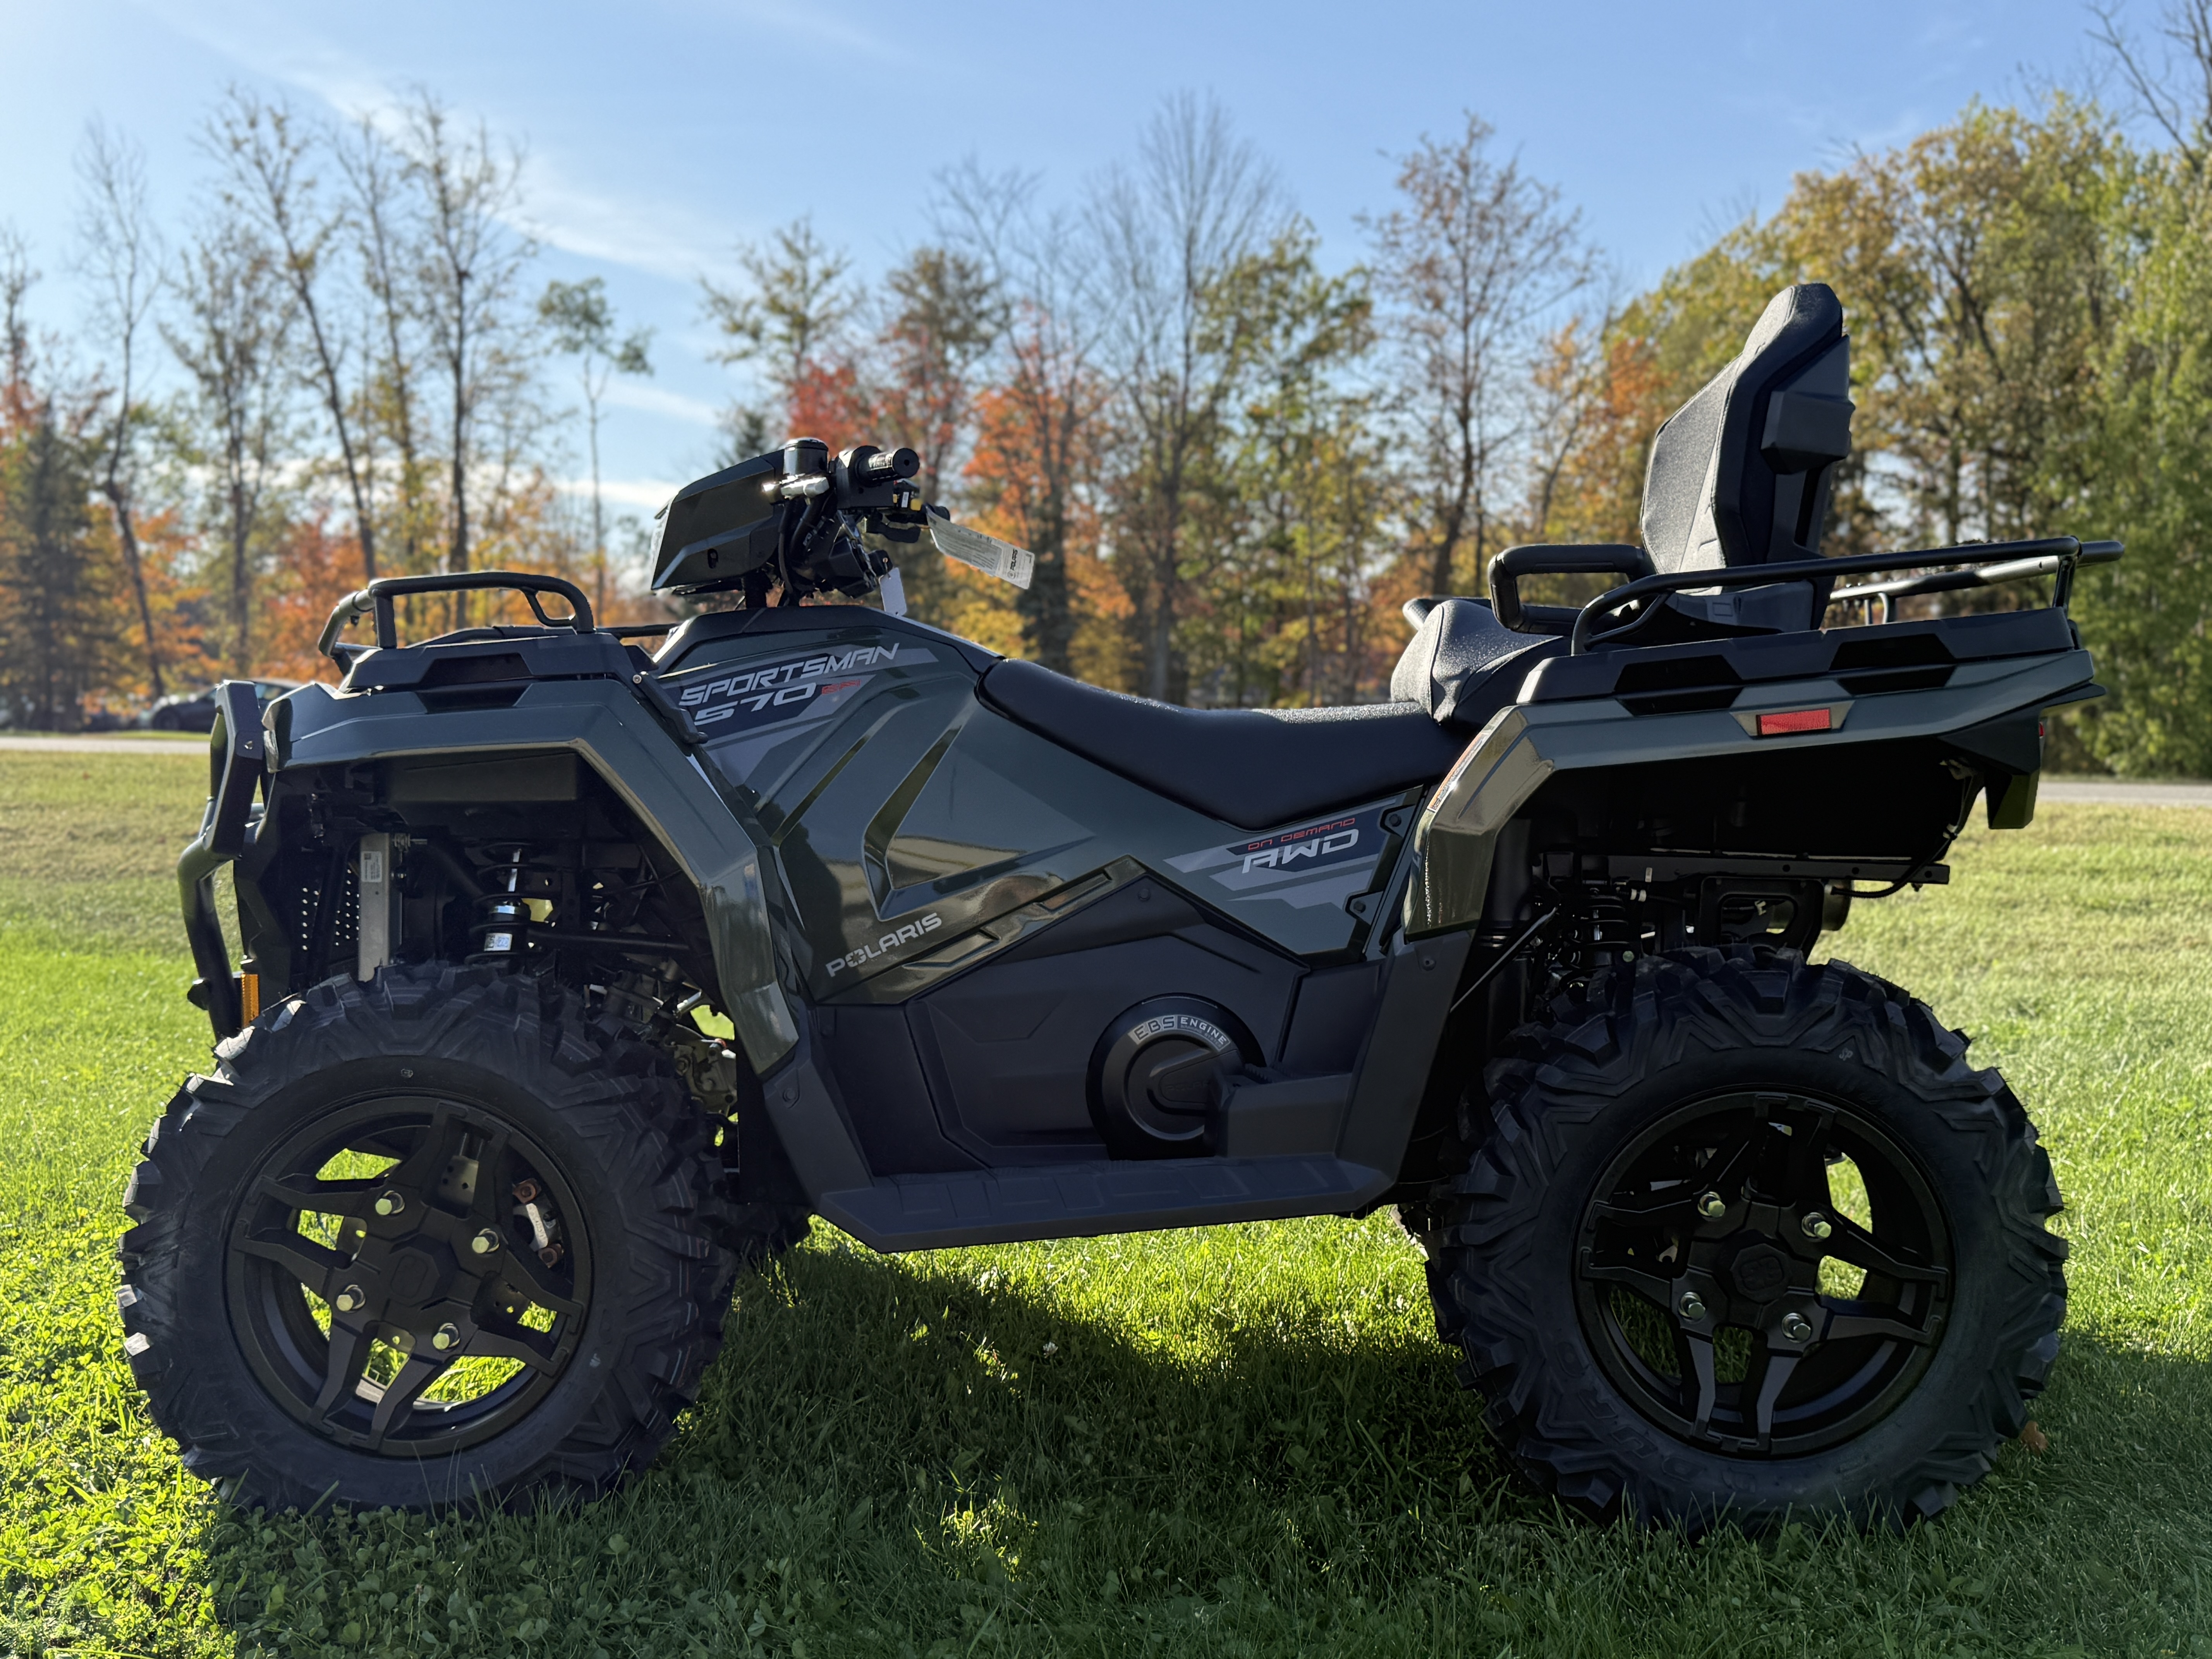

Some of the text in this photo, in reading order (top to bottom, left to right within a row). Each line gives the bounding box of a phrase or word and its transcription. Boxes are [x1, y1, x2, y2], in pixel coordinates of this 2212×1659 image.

[678, 643, 900, 706] SPORTSMAN
[694, 682, 817, 726] 570
[1242, 828, 1359, 874] AWD
[1248, 817, 1355, 851] ON DEMAND
[825, 912, 942, 977] POLARIS
[1134, 1015, 1227, 1045] EBS ENGINE
[1555, 1341, 1705, 1482] DURO
